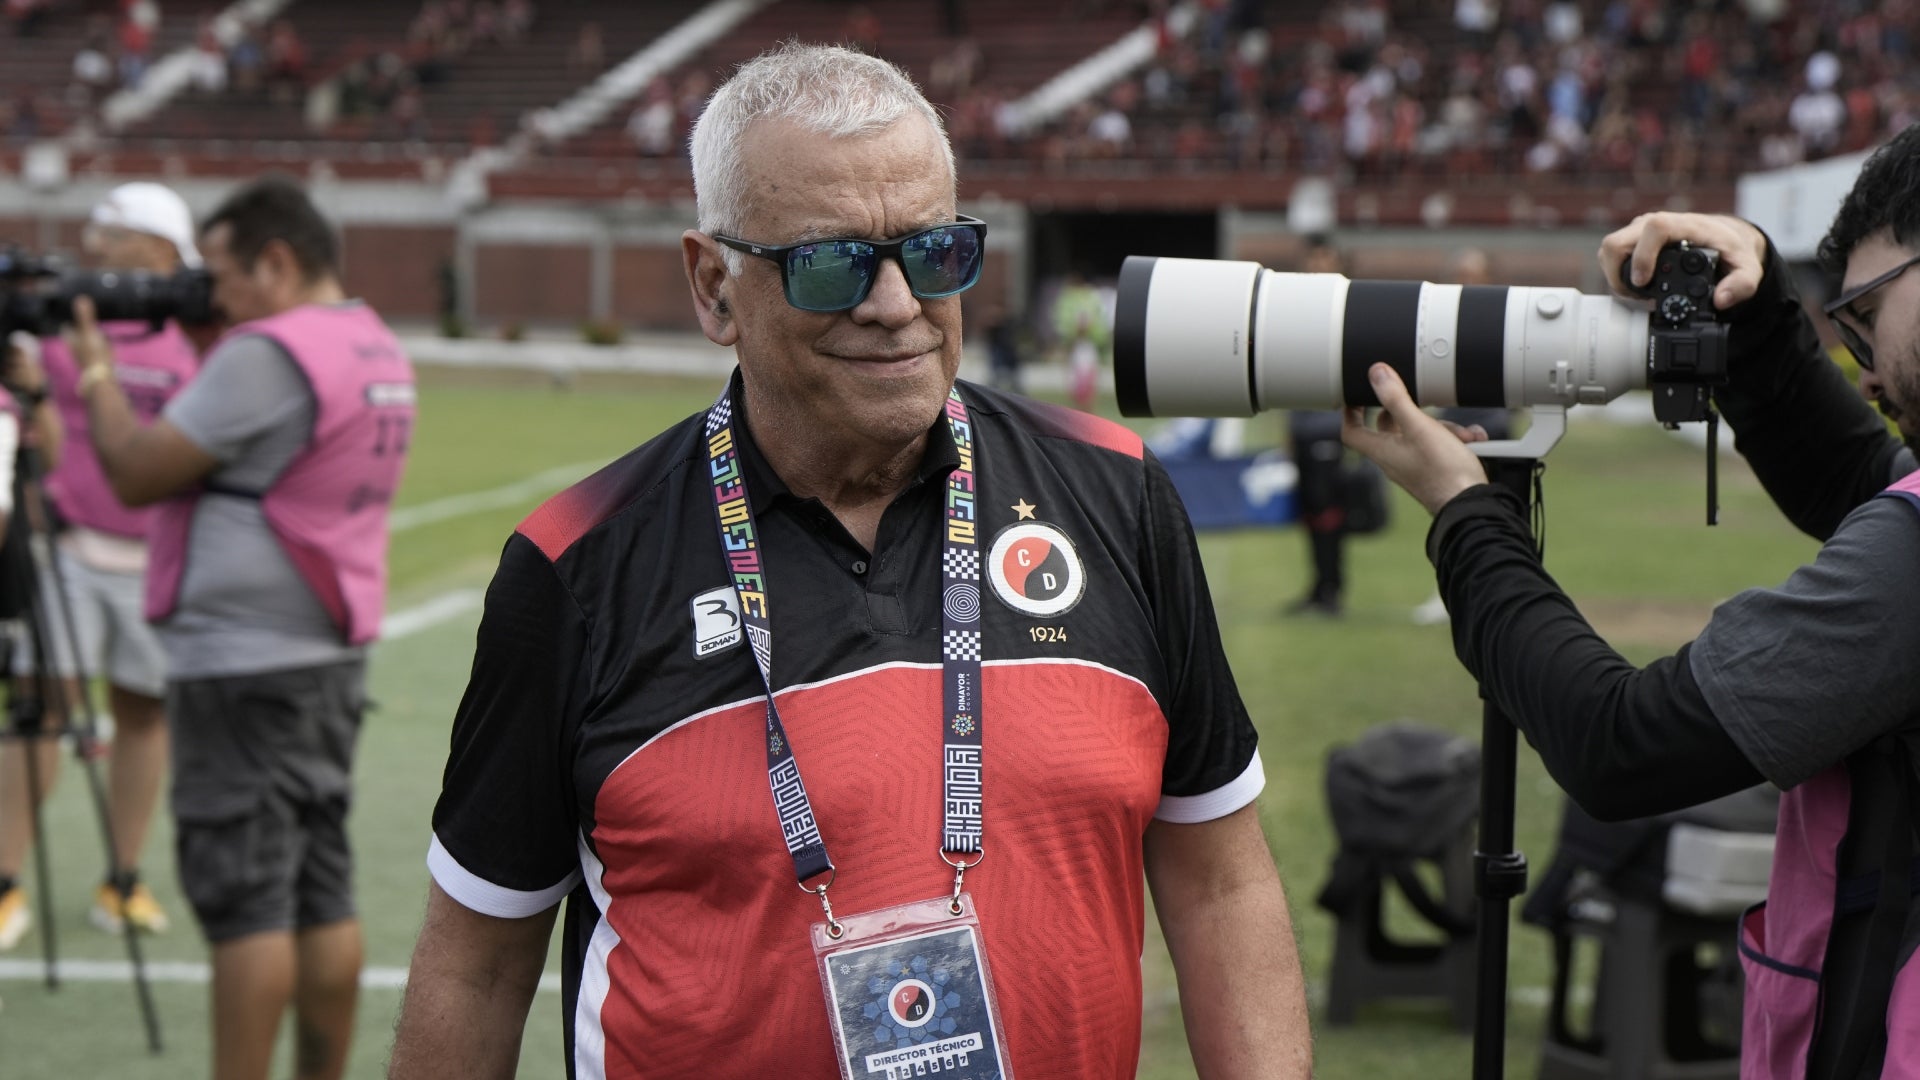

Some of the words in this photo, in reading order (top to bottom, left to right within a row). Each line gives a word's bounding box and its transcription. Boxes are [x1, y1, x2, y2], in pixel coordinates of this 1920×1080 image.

[1017, 548, 1031, 567] C
[1042, 572, 1057, 591] D
[701, 633, 736, 652] BOMAN
[1029, 626, 1067, 643] 1924
[958, 673, 966, 711] DIMAYOR
[902, 992, 910, 1004] C
[915, 1004, 923, 1016] D
[872, 1048, 927, 1067] DIRECTOR
[929, 1038, 975, 1055] TÉCNICO
[903, 1068, 910, 1077] 2
[917, 1065, 925, 1073] 4
[932, 1062, 938, 1070] 5
[946, 1059, 952, 1067] 6
[960, 1055, 966, 1064] 7
